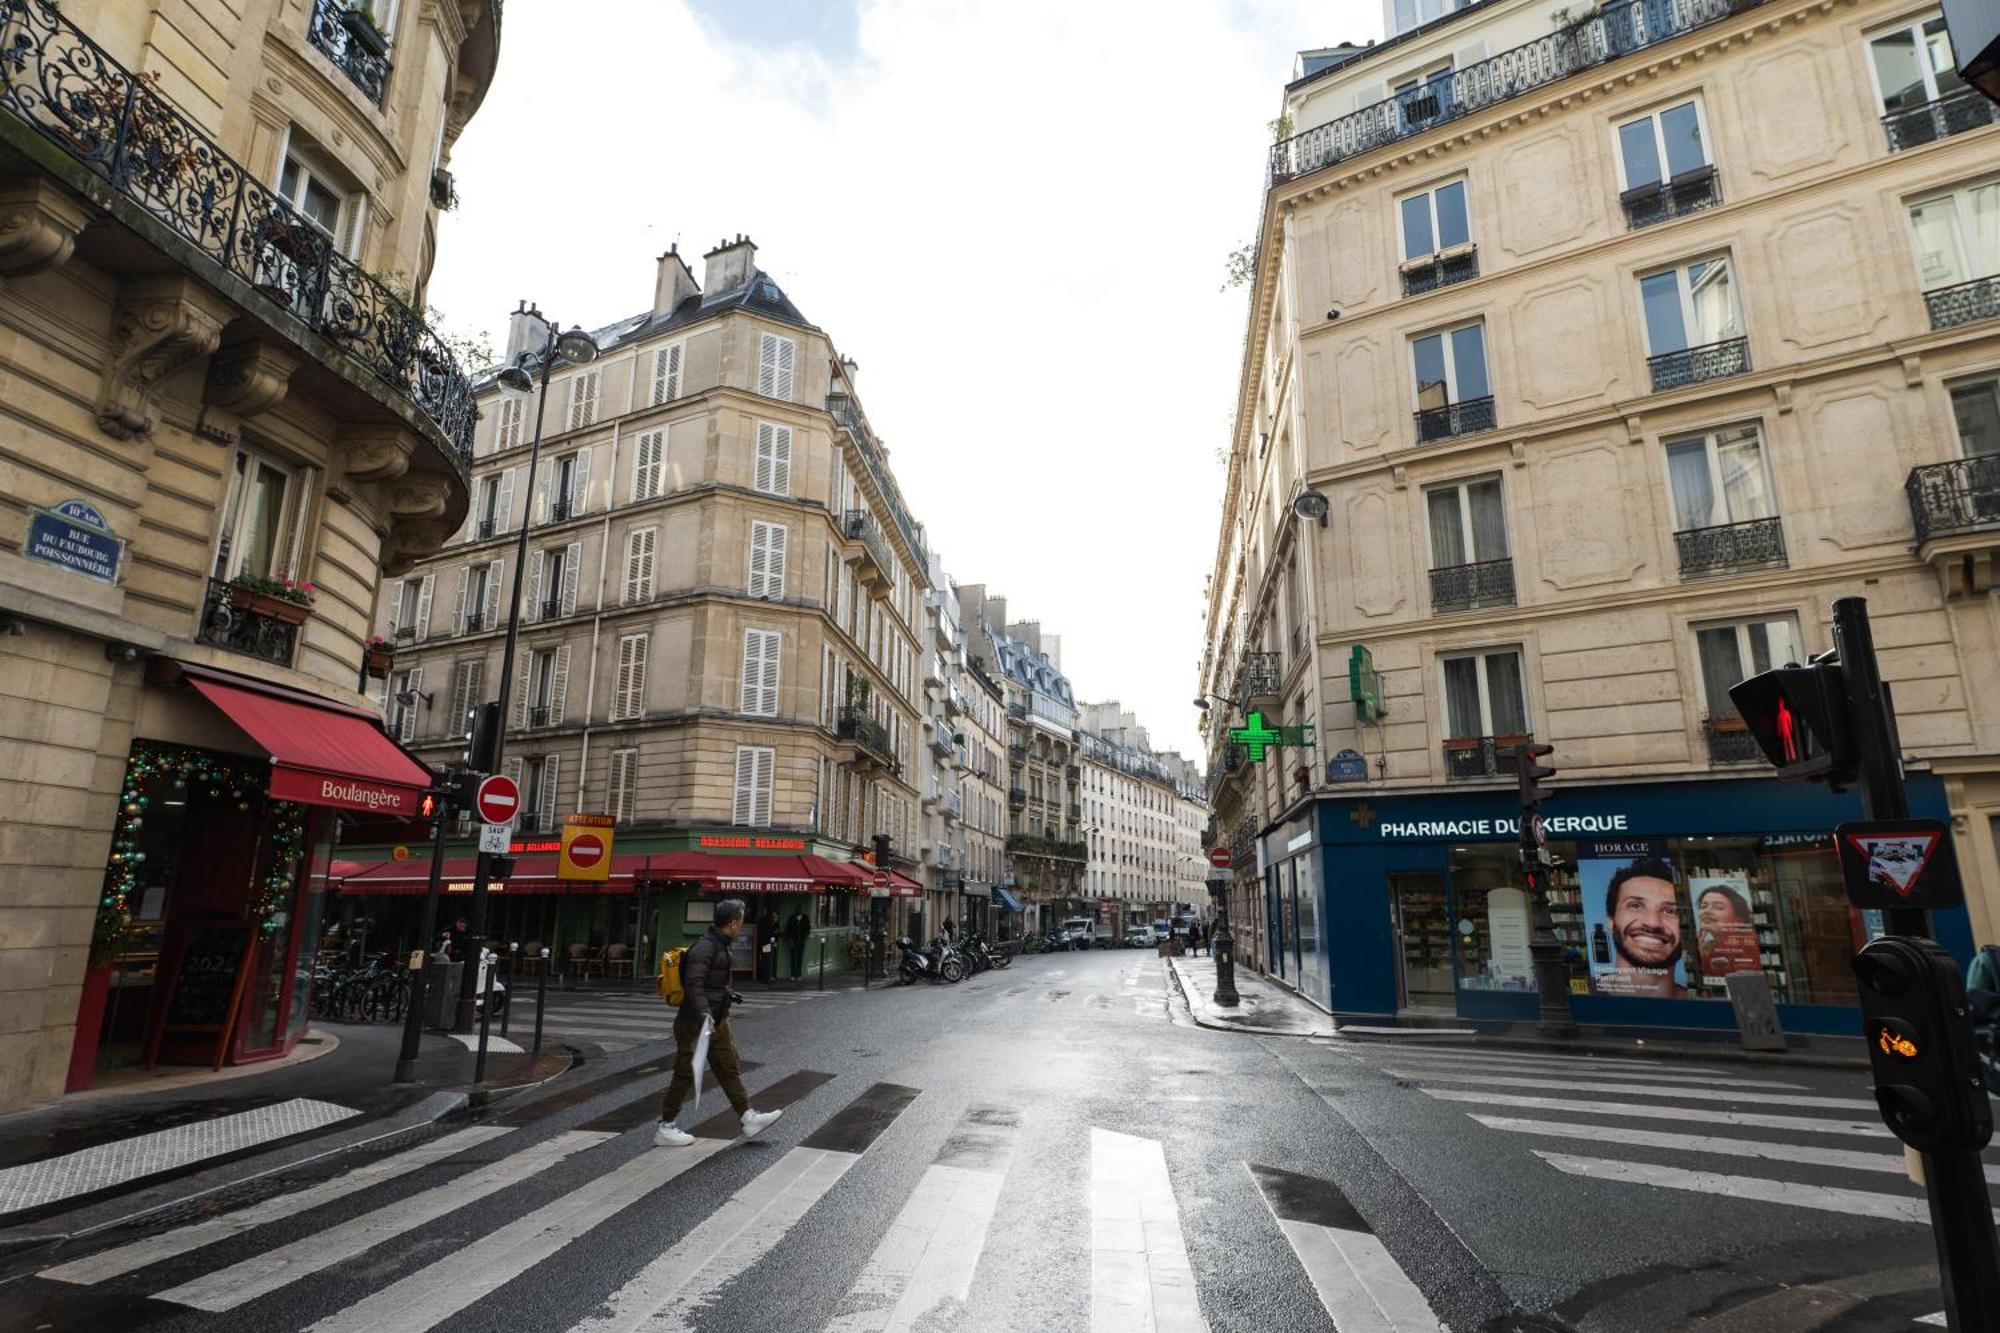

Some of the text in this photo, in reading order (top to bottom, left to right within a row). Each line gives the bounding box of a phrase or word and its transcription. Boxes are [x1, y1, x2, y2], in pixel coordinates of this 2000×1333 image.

[68, 529, 91, 544] RUE
[42, 532, 109, 563] DU FAUBOURG
[321, 780, 401, 809] Boulangère
[568, 814, 613, 826] ATTENTION
[1380, 814, 1628, 837] PHARMACIE DUKERQUE
[488, 826, 505, 835] SAUF
[1593, 842, 1649, 853] HORACE
[720, 881, 809, 892] BRASSERIE BELLANGER
